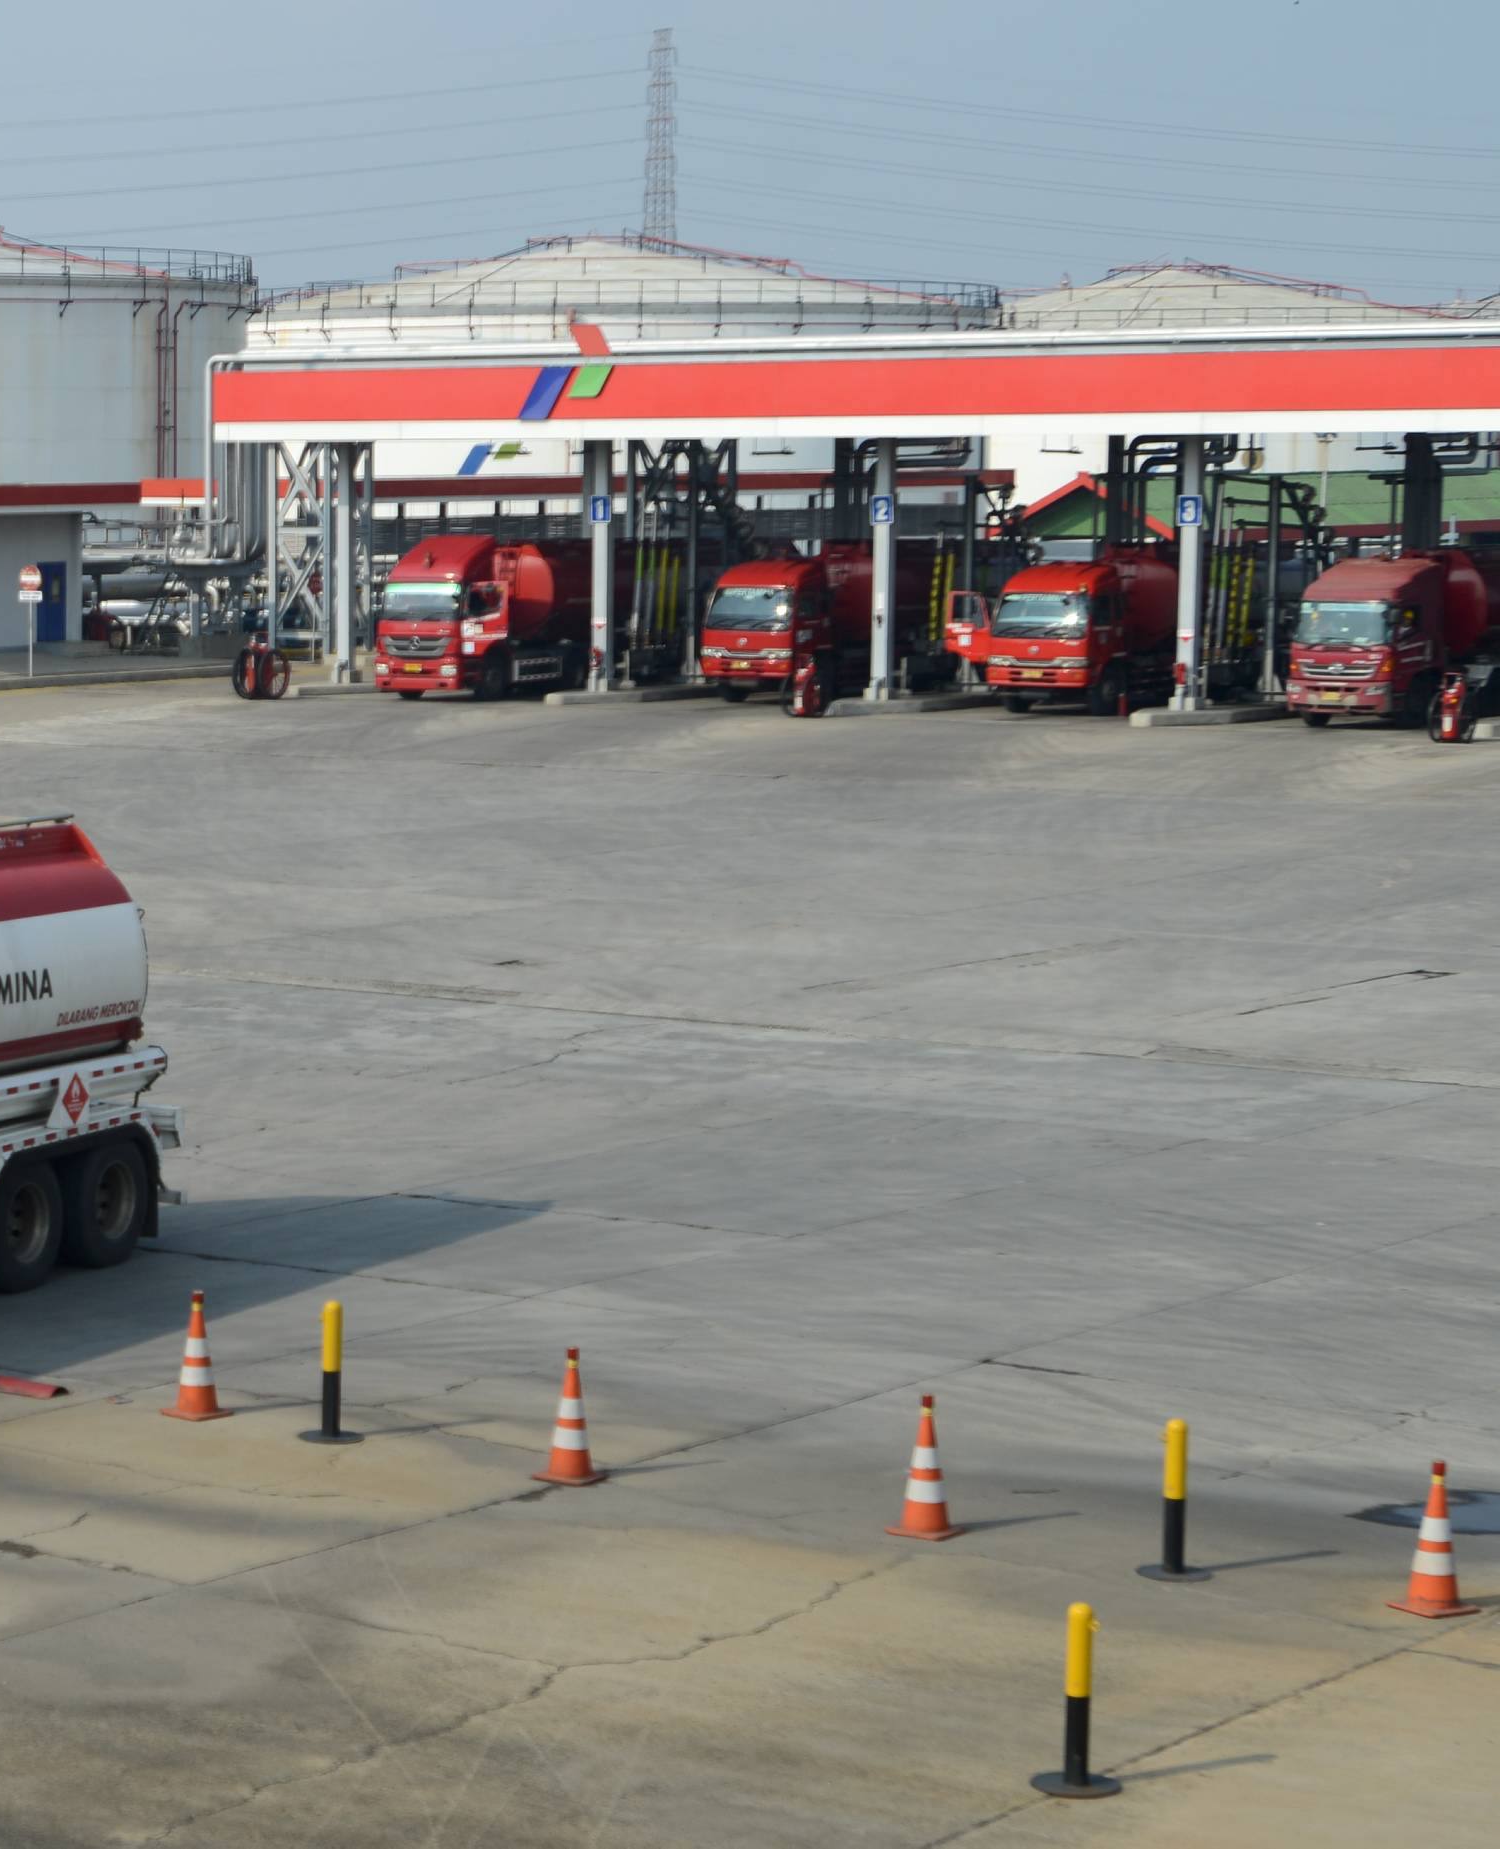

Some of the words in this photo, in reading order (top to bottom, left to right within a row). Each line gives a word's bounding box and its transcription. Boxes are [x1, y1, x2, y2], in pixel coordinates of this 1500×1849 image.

[875, 500, 888, 521] 2
[1182, 500, 1196, 522] 3
[57, 1006, 99, 1027] DILARANG
